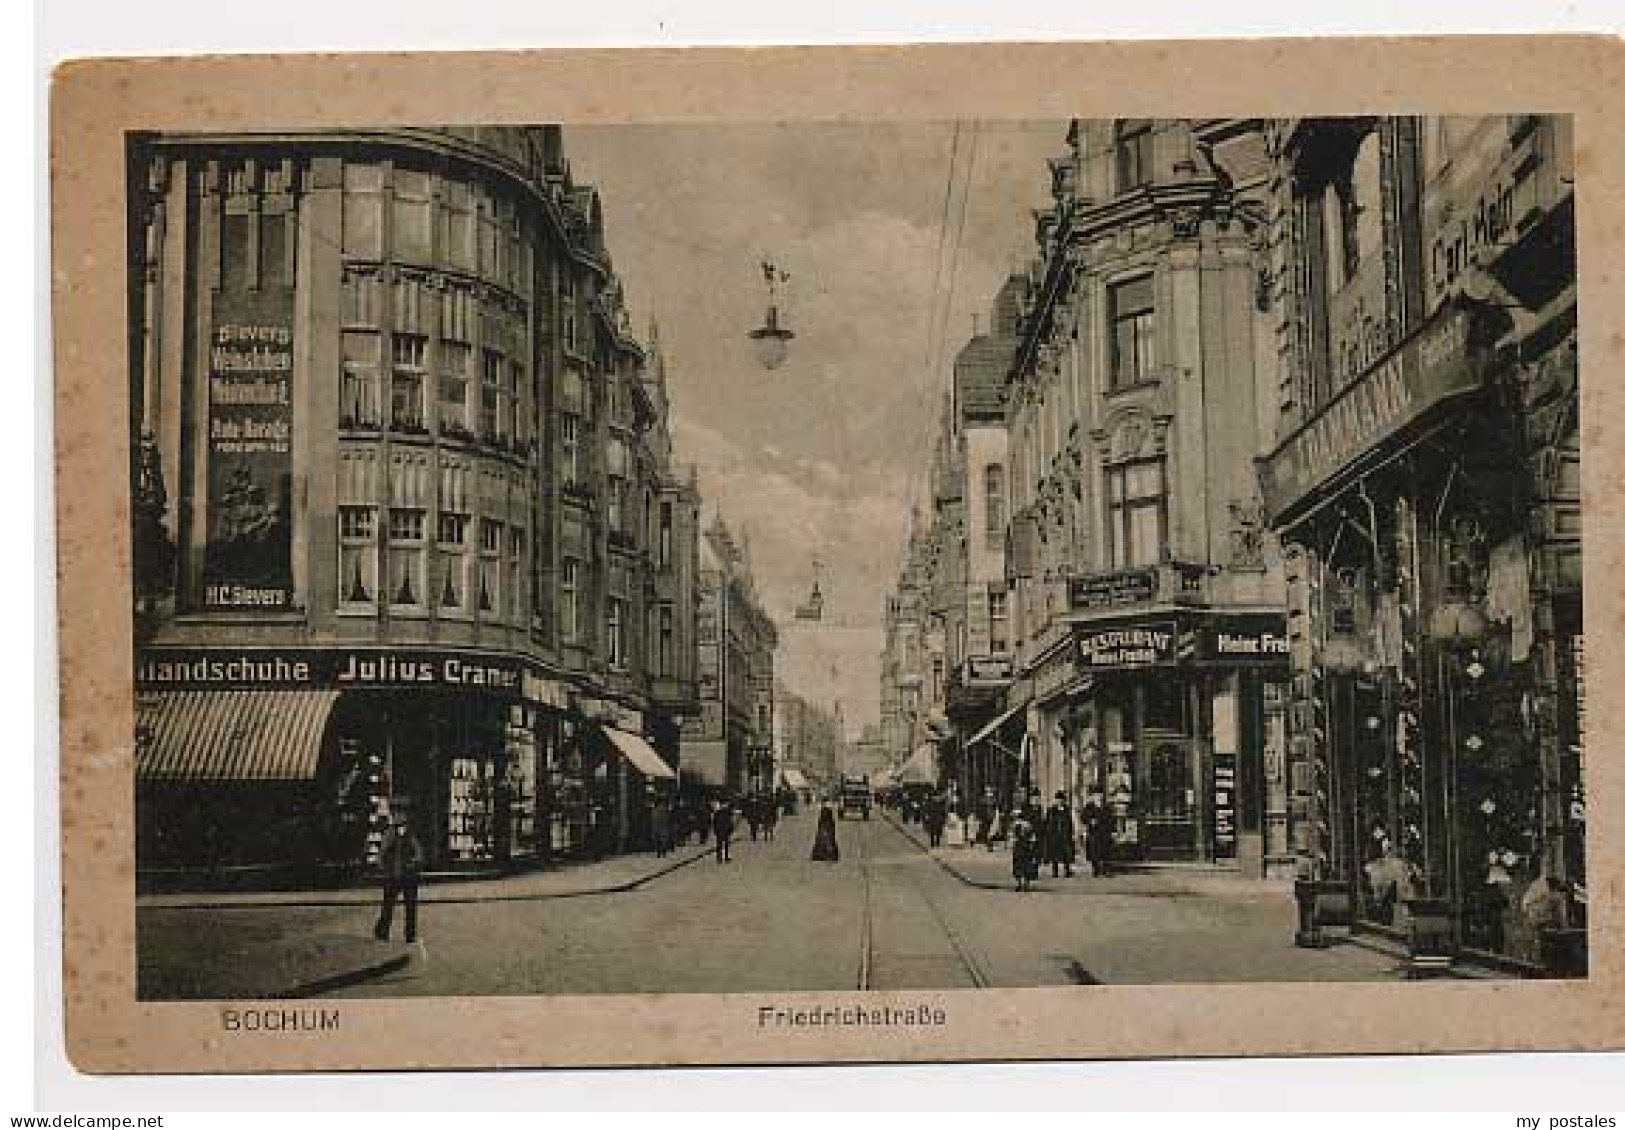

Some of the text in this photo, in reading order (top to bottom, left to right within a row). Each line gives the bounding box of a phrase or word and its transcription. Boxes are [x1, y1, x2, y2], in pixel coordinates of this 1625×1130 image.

[337, 654, 434, 681] Julius
[223, 1009, 340, 1031] BOCHUM
[758, 1004, 946, 1027] Friedrichstraße
